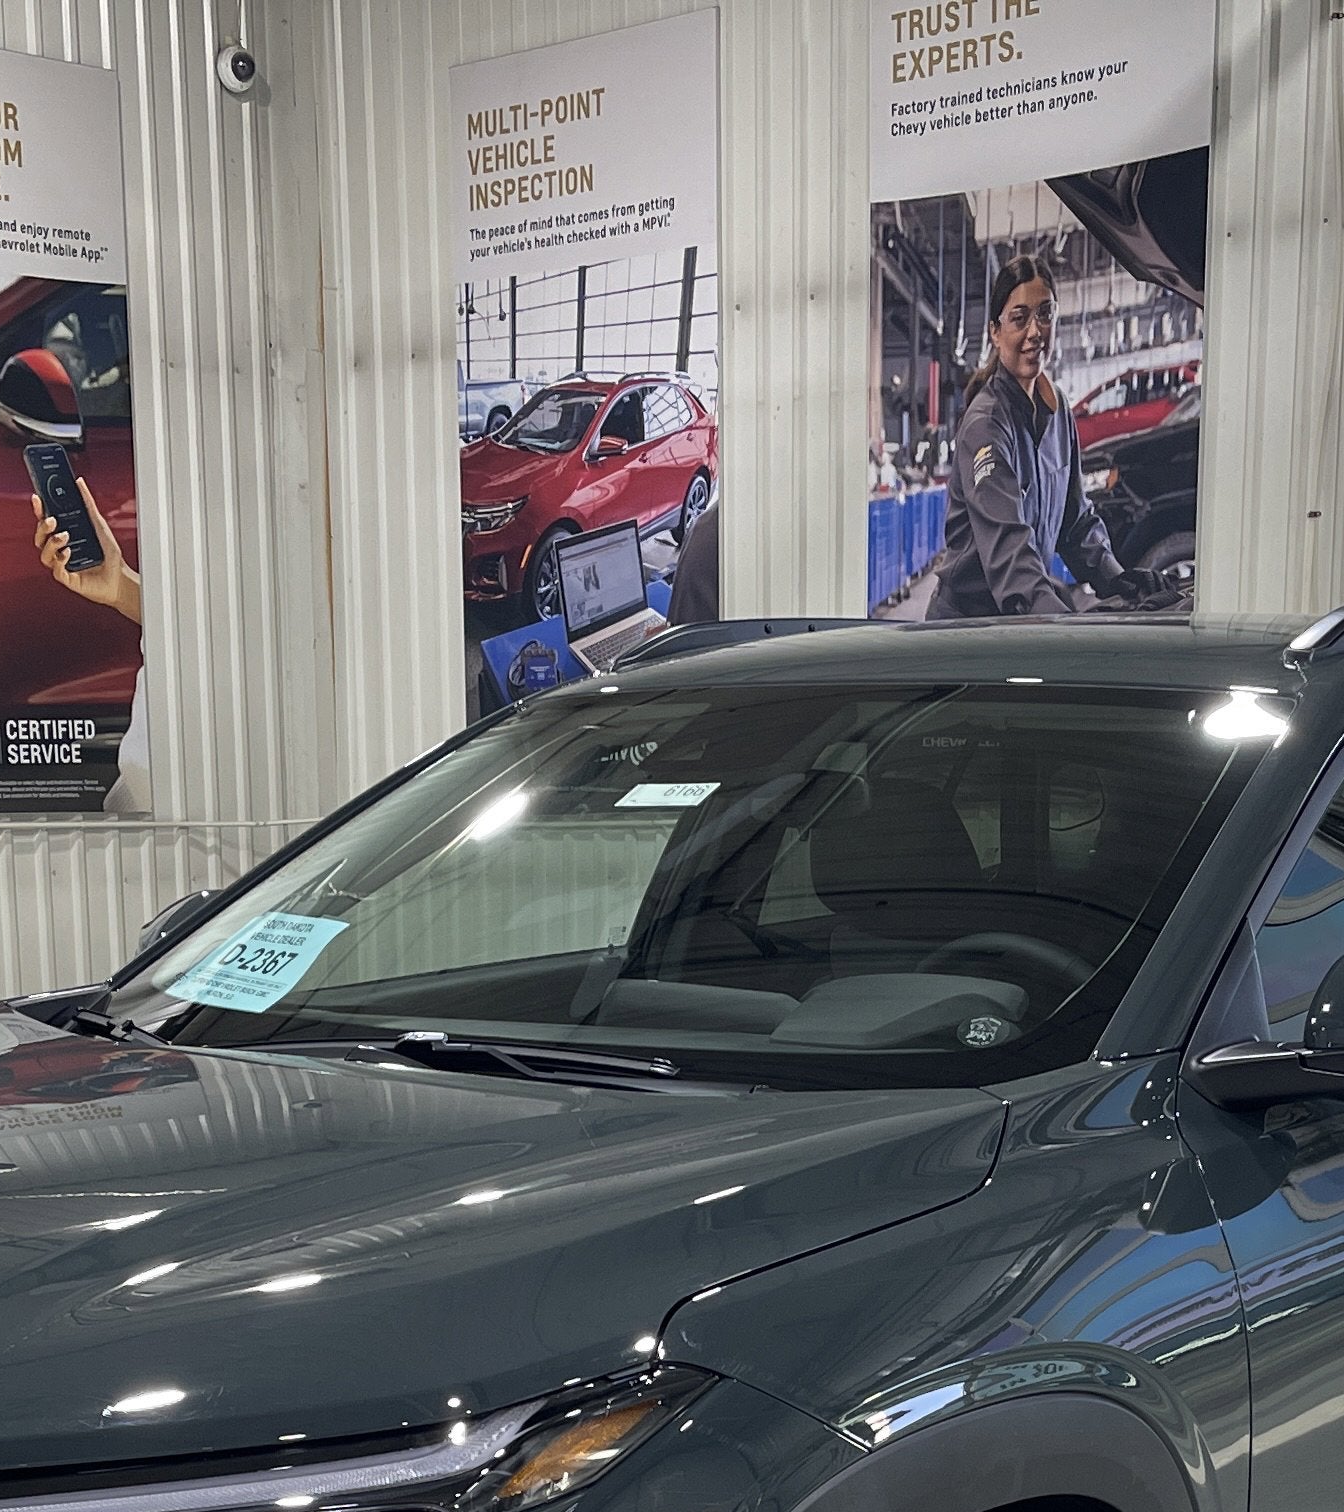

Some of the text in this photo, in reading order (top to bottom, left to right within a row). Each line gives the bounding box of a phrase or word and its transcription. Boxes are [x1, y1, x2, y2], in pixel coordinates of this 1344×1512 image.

[891, 0, 977, 43] TRUST
[892, 30, 1023, 84] EXPERTS.
[891, 60, 1128, 117] Factory trained technicians know your
[467, 87, 605, 141] MULTI-POINT
[891, 89, 1098, 137] Chevy vehicle better than anyone.
[467, 134, 555, 176] VEHICLE
[469, 164, 594, 212] INSPECTION
[20, 223, 49, 240] enjoy
[52, 228, 91, 241] remote
[469, 196, 675, 241] The peace of mind that comes from getting
[43, 242, 78, 258] Mobile
[469, 246, 491, 262] your
[493, 237, 532, 255] vehicle's
[534, 232, 564, 249] health
[566, 225, 607, 244] checked
[609, 221, 631, 237] with
[633, 222, 639, 232] a
[6, 719, 96, 740] CERTIFIED
[7, 743, 82, 764] SERVICE
[218, 943, 299, 977] D-2367
